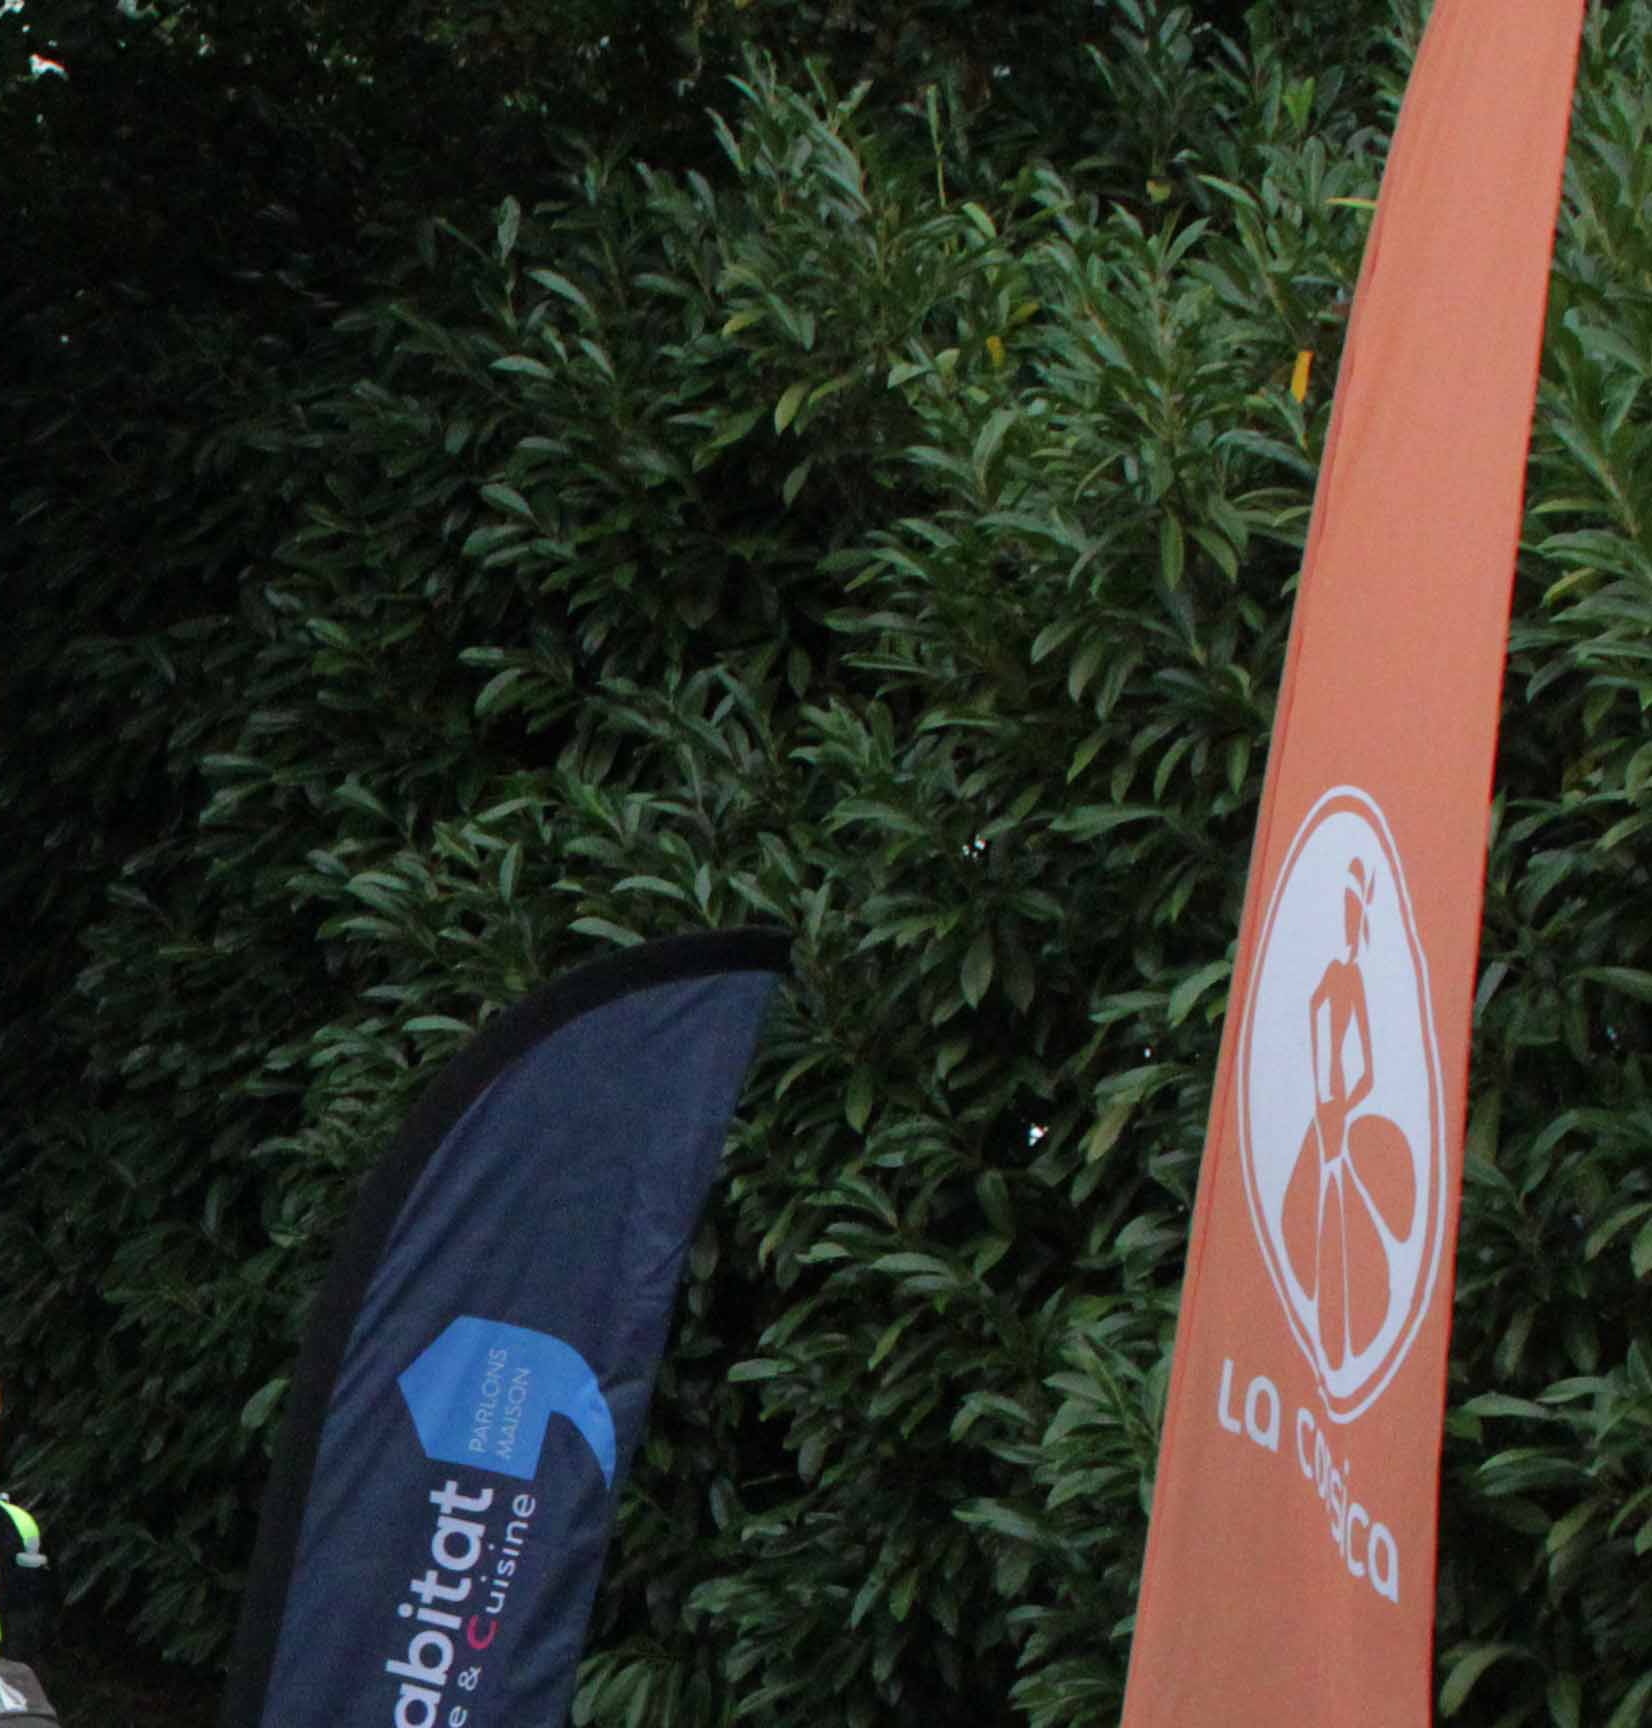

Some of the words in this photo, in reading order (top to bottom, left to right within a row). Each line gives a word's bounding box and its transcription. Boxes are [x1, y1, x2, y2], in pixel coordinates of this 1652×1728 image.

[468, 1347, 508, 1454] PARLONS
[496, 1367, 532, 1460] MAISON
[466, 1492, 536, 1651] Cuisine
[457, 1666, 481, 1692] &
